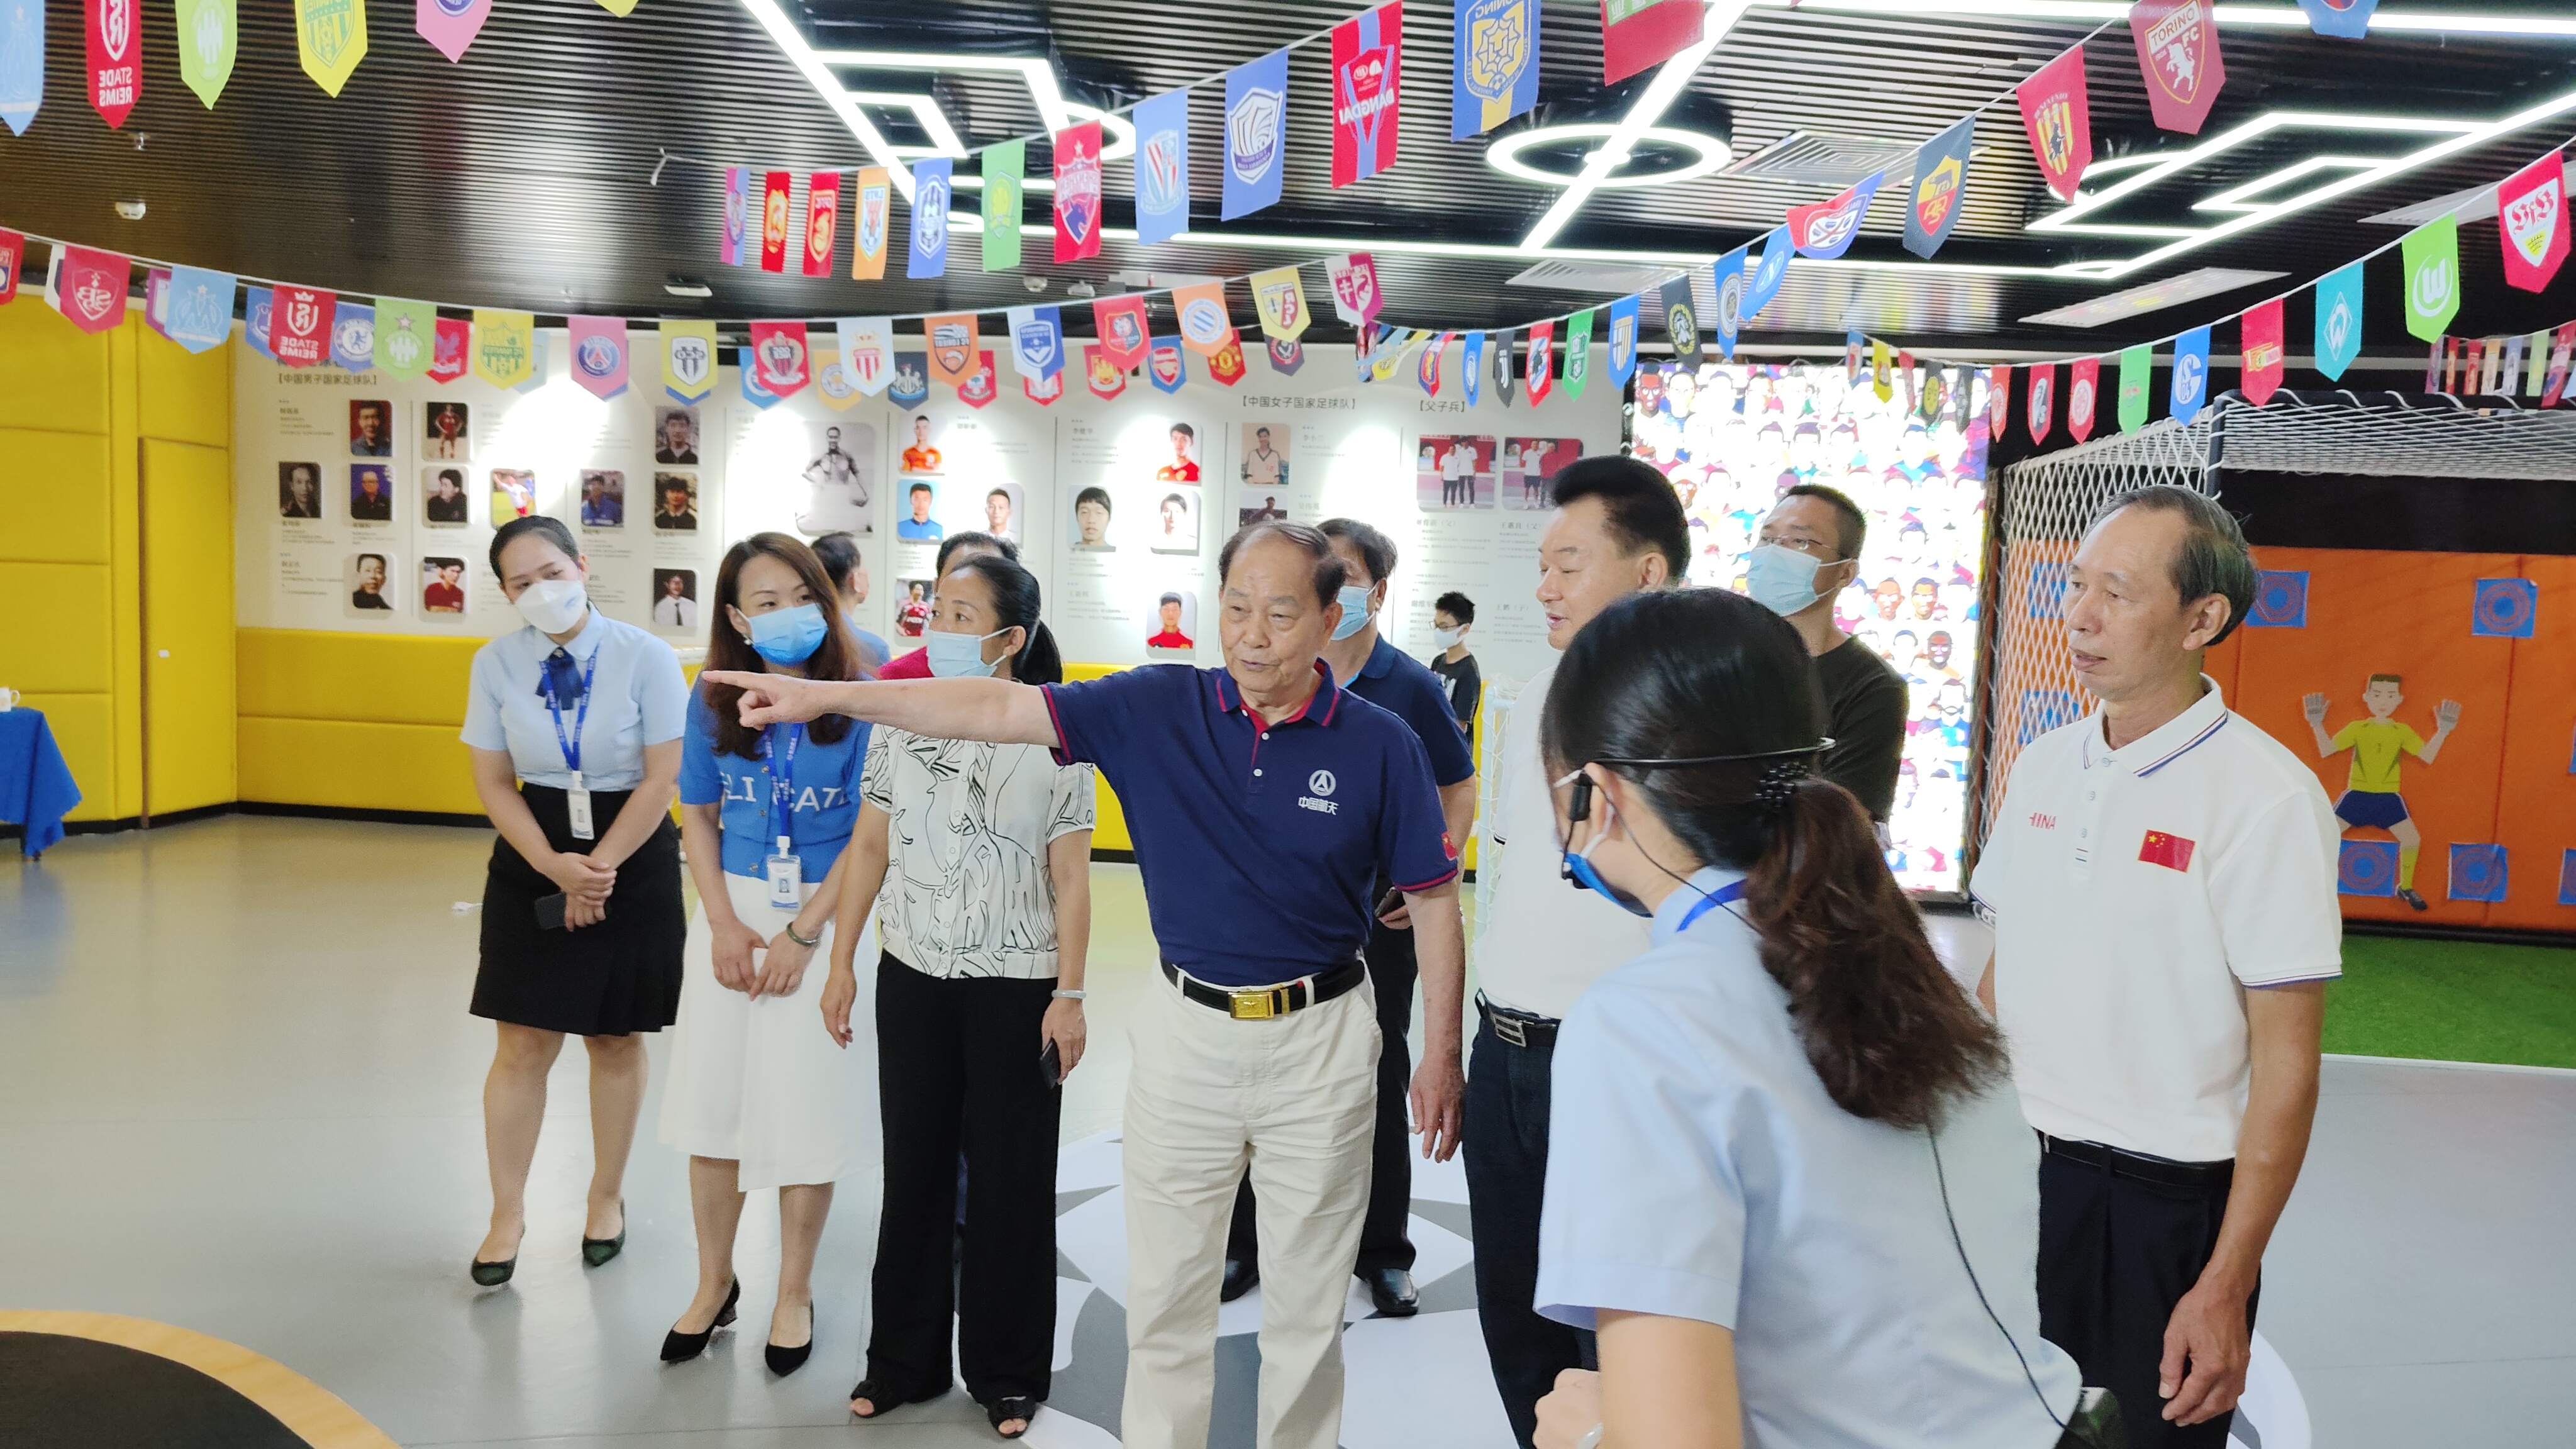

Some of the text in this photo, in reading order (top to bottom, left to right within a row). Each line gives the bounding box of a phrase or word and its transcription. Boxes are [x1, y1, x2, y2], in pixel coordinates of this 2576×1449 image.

[2151, 7, 2195, 47] TORINO
[2181, 26, 2200, 48] FC
[1242, 395, 1356, 409] 【中国女子国家足球队】
[1420, 399, 1465, 413] 【父子兵】
[1297, 796, 1339, 816] 中国航天
